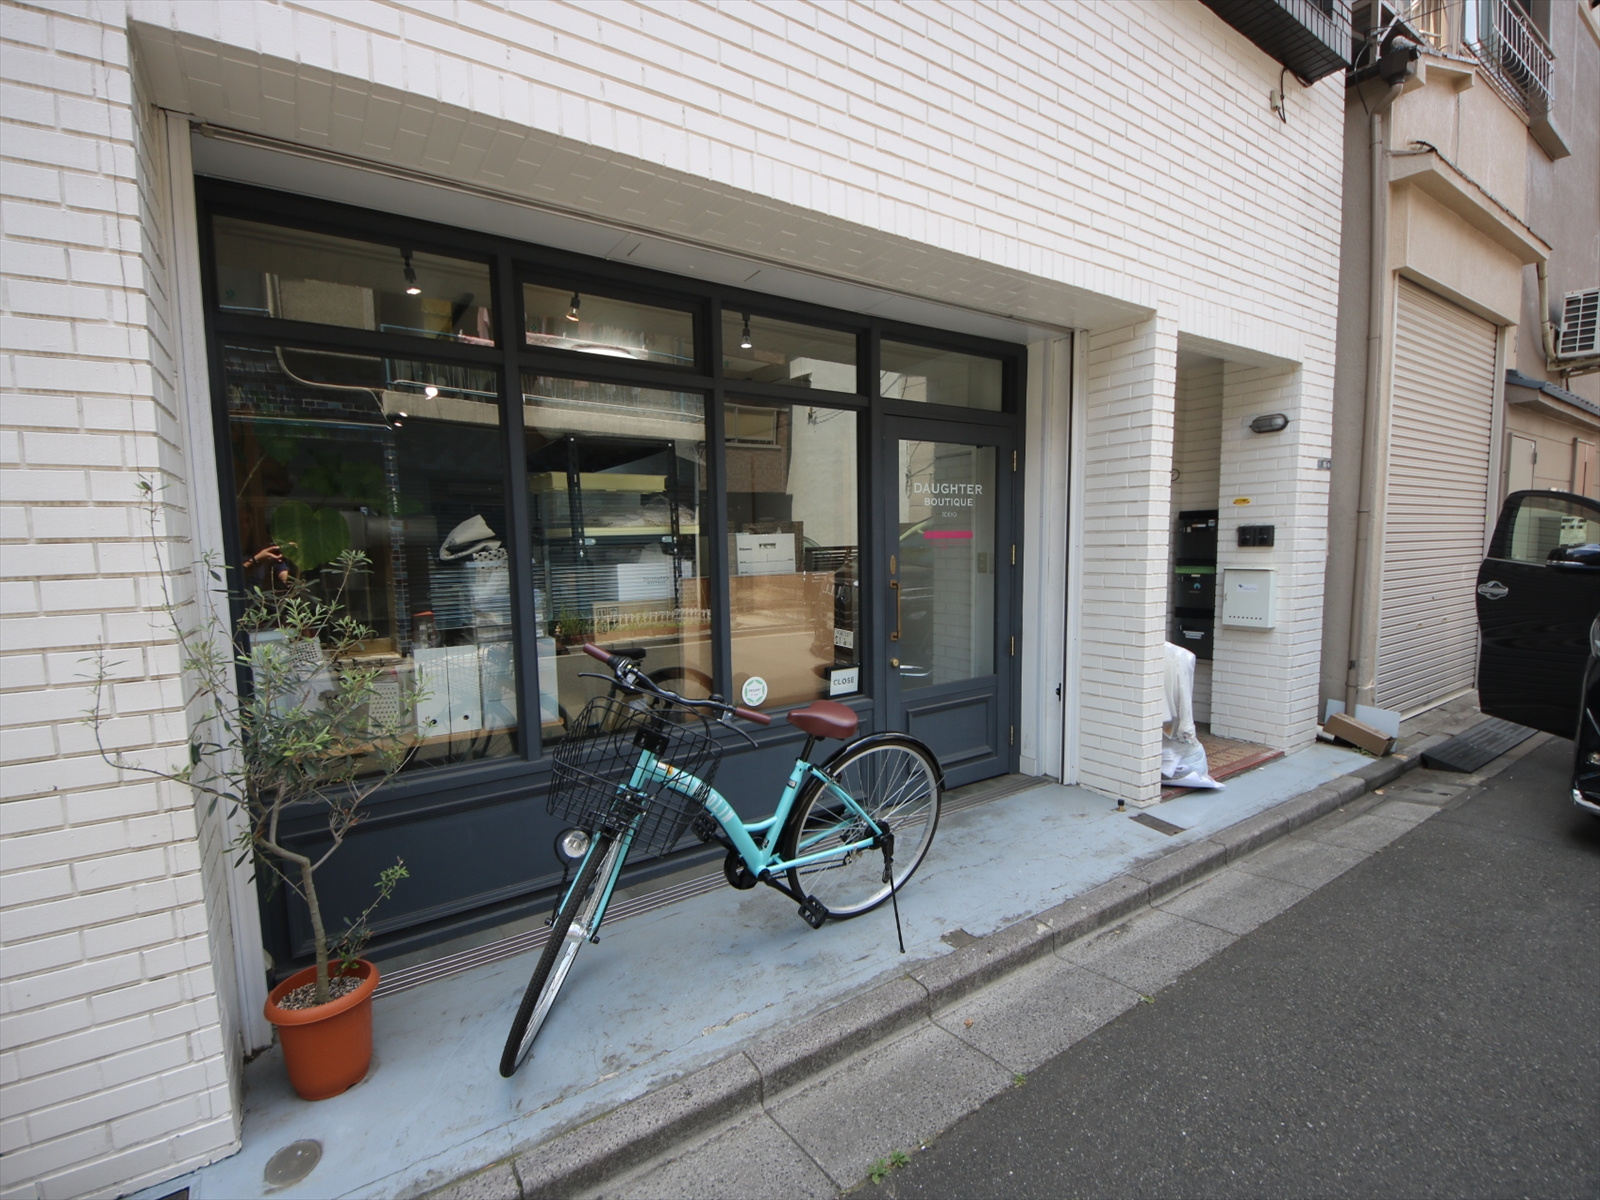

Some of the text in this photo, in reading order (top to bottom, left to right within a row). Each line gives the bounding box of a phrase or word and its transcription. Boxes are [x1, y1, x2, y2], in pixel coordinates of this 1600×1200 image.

[914, 482, 983, 495] DAUGHTER
[924, 498, 974, 507] BOUTIQUE
[833, 676, 855, 686] CLOSE
